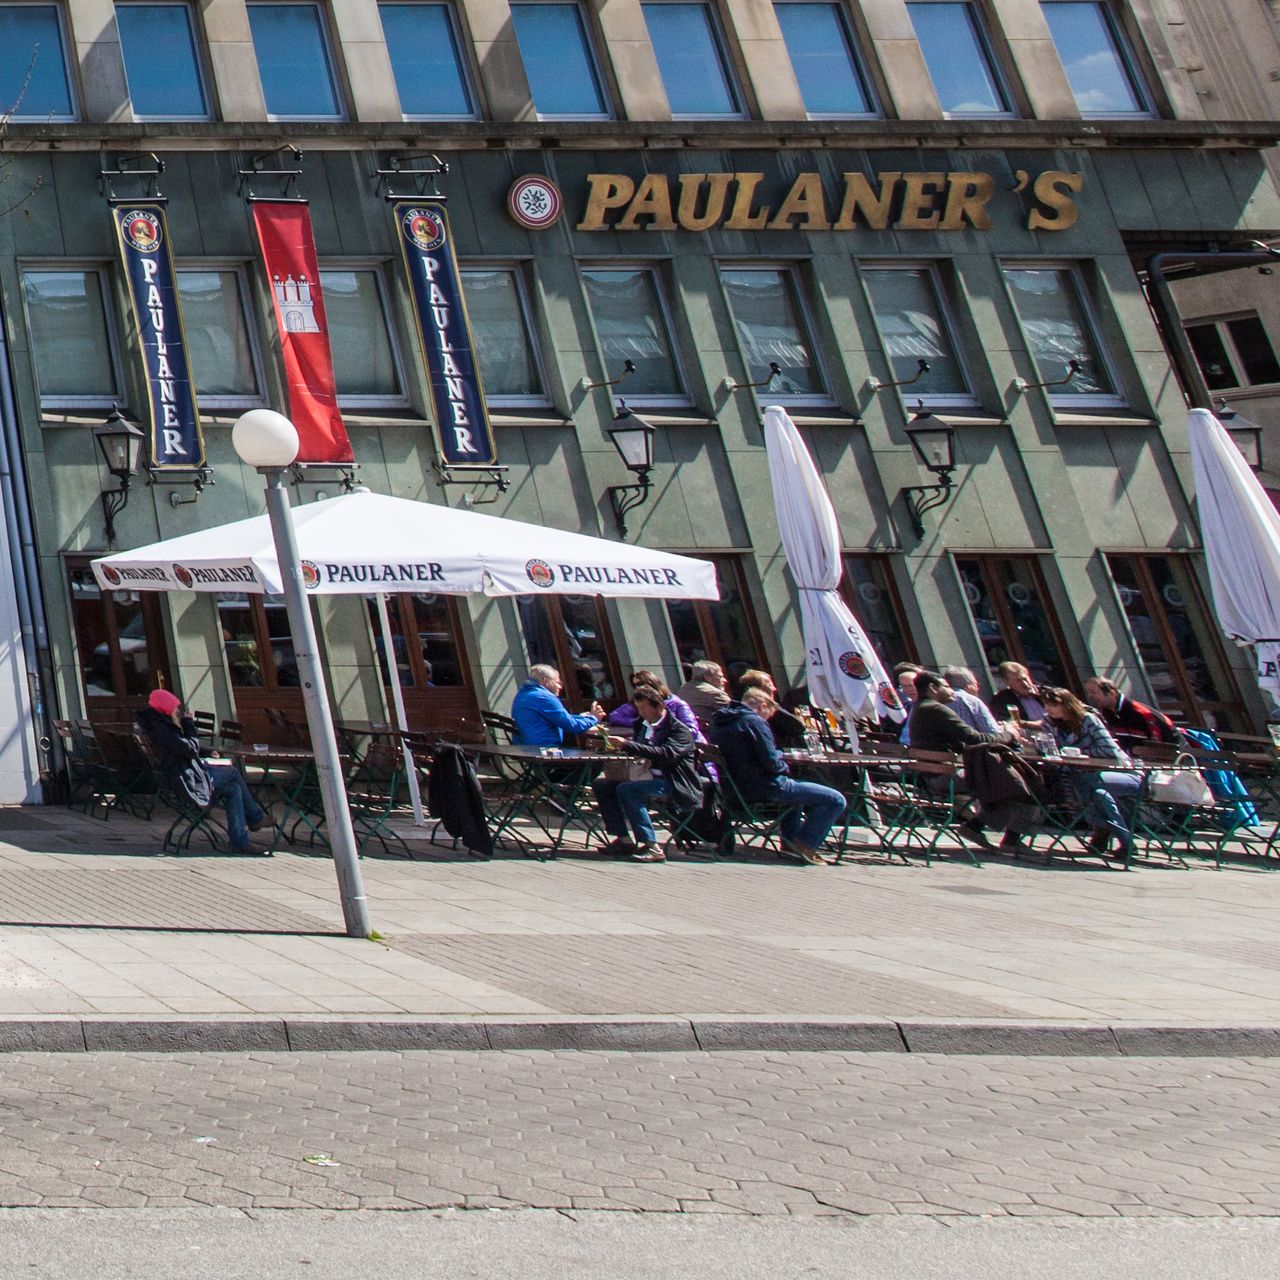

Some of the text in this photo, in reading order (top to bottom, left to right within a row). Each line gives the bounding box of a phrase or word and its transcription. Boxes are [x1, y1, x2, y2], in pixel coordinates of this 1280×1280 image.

[140, 258, 188, 455] PAULANER
[421, 256, 479, 454] PAULANER
[118, 567, 170, 582] PAULANER
[191, 565, 259, 585] PAULANER
[327, 562, 446, 583] PAULANER
[557, 564, 683, 586] PAULANER
